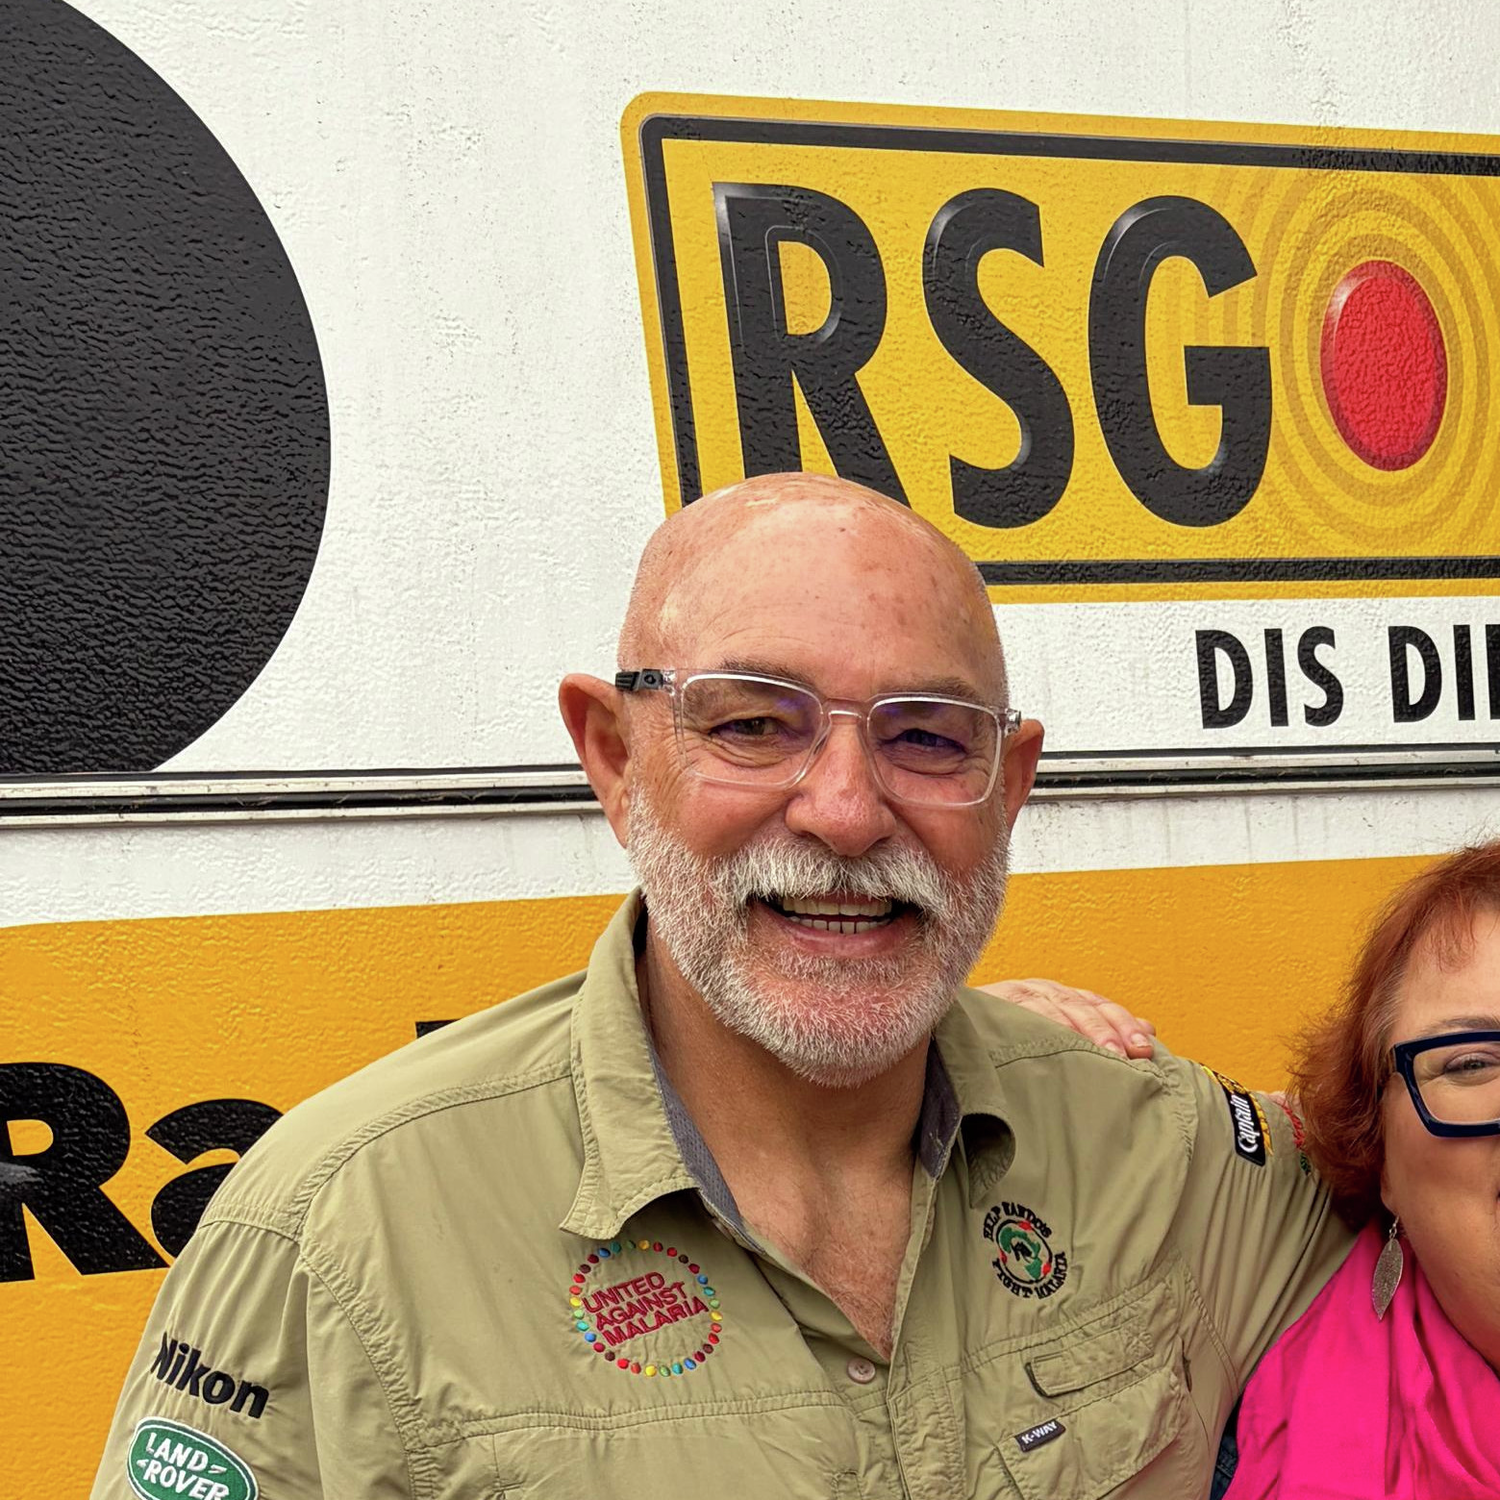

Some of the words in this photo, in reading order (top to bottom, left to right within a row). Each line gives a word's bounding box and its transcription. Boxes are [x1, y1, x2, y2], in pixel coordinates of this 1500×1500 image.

[711, 180, 1272, 529] RSG
[1195, 624, 1346, 730] DIS
[1230, 1094, 1261, 1153] Captain
[582, 1271, 665, 1314] UNITED
[596, 1281, 687, 1330] AGAINST
[601, 1296, 709, 1346] MALARIA
[150, 1331, 270, 1419] Nikon
[1021, 1421, 1057, 1444] K-WAY
